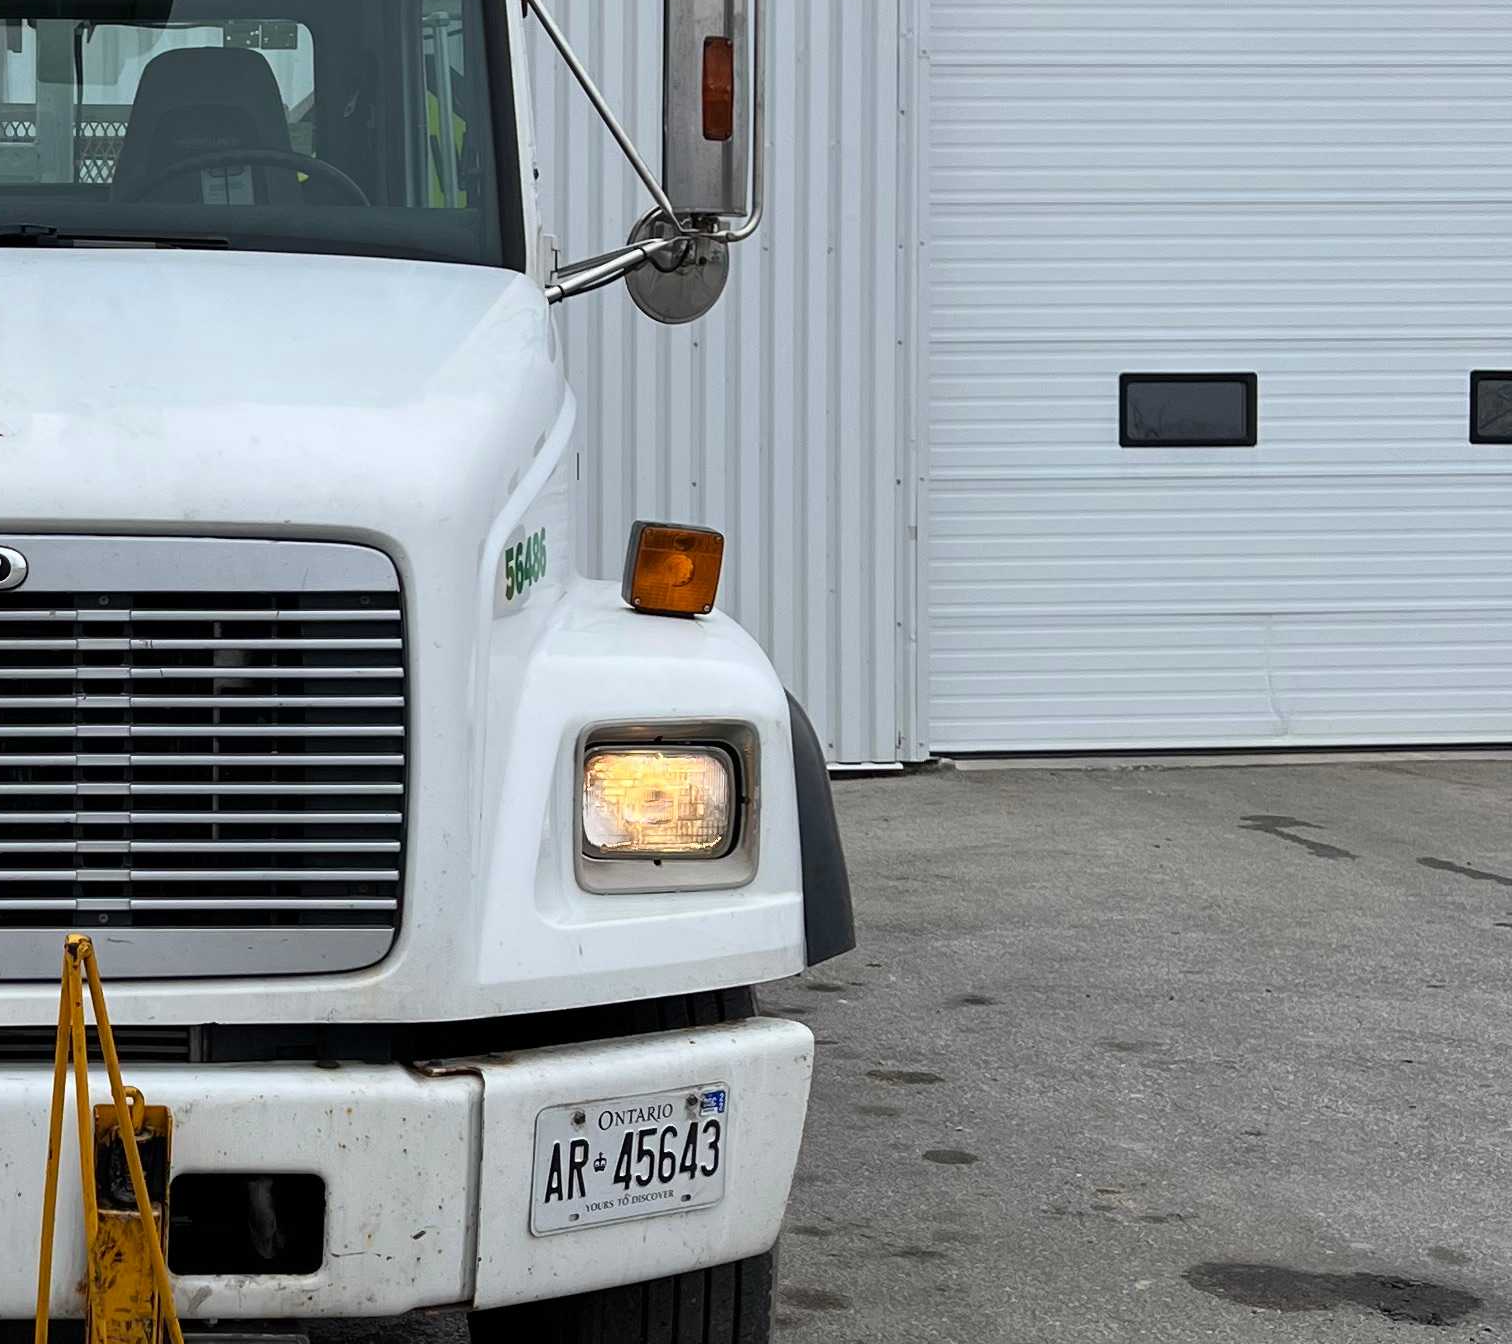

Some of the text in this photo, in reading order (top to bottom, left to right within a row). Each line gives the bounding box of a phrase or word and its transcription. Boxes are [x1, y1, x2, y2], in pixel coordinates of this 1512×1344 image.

[504, 526, 547, 601] 56486
[544, 1119, 721, 1204] AR 45643
[585, 1200, 615, 1213] YOURS
[631, 1189, 675, 1205] DISCOVER
